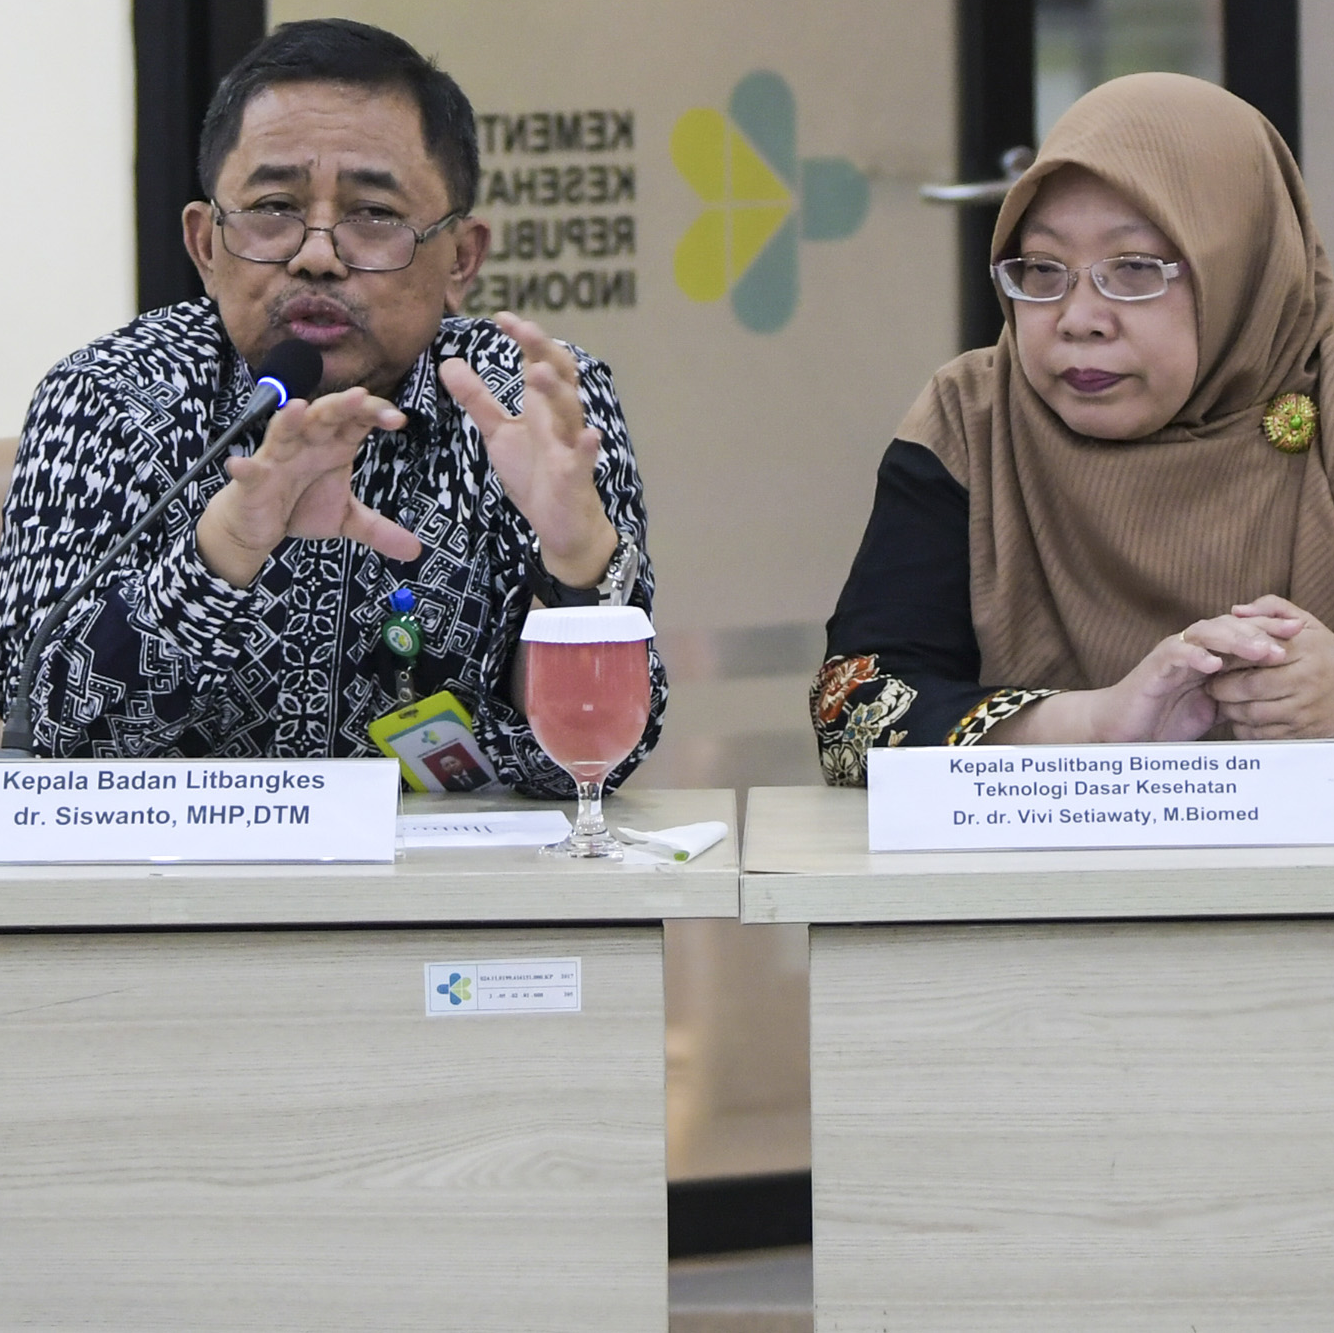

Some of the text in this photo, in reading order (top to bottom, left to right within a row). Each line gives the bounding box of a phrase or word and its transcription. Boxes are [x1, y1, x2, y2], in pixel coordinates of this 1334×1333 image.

[951, 756, 1260, 776] Kepala Puslitbang Biomedis dan
[4, 770, 324, 794] Kepala Badan Litbangkes
[974, 780, 1236, 799] Teknologi Dasar Kesehatan
[14, 806, 309, 827] dr. Siswanto, MHP,DTM
[954, 807, 1258, 825] Dr. dr. Vivi Setiawaty, M.Biomed
